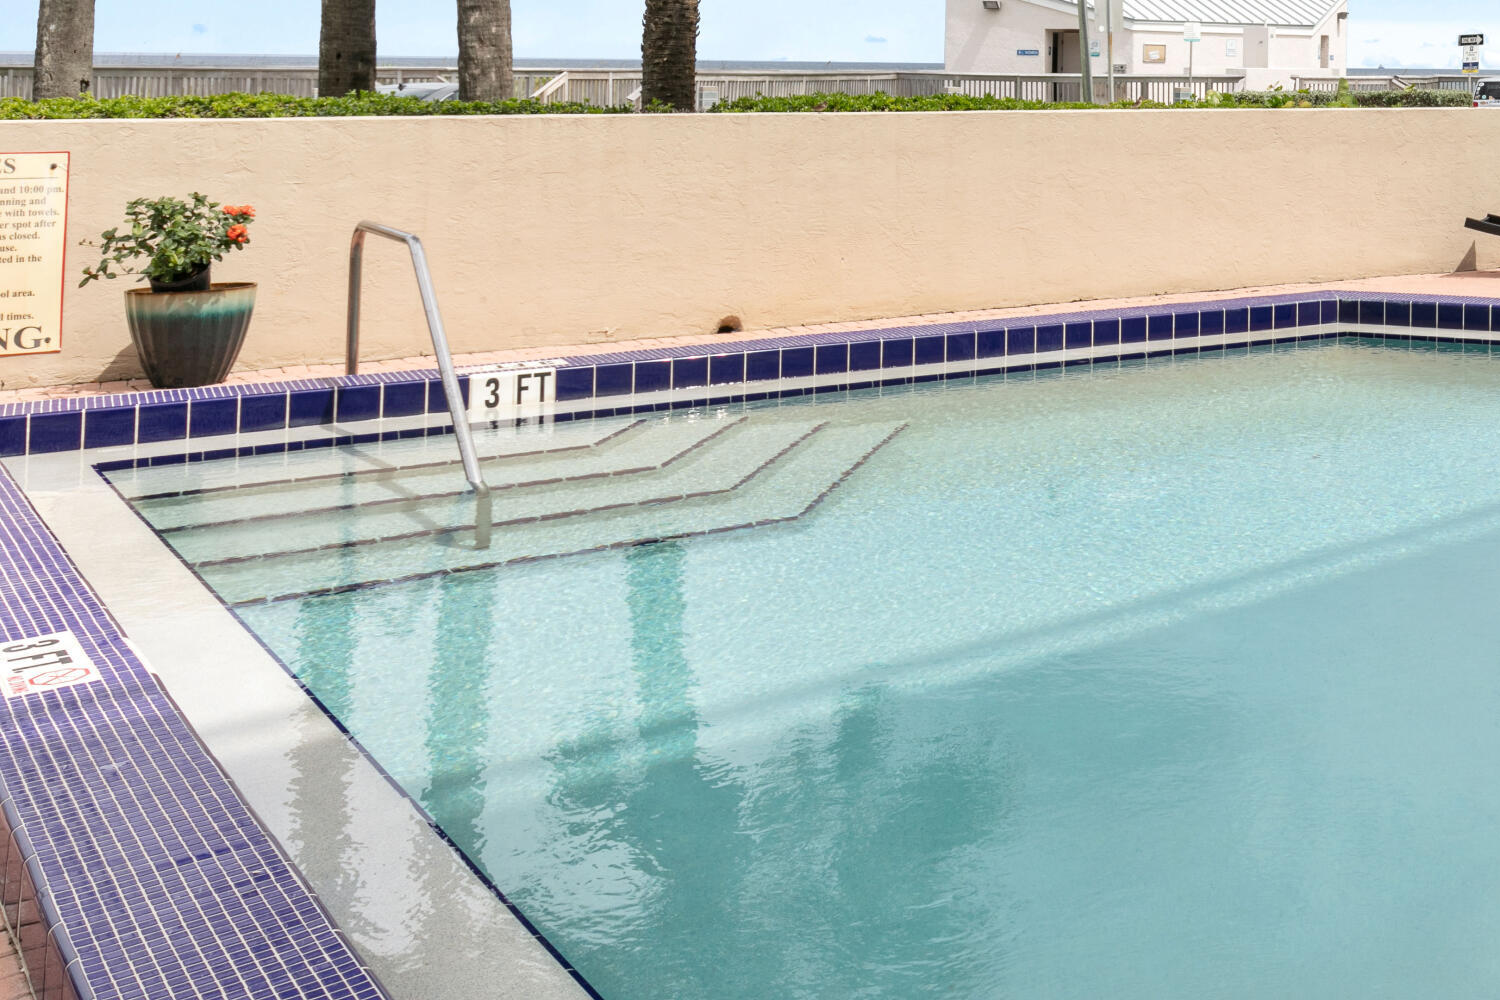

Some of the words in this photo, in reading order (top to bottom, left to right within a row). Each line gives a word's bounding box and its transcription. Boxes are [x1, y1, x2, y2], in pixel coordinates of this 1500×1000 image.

[0, 158, 16, 174] S
[20, 185, 44, 194] 10:00
[29, 196, 46, 205] and
[5, 208, 25, 217] with
[28, 207, 60, 217] towels.
[12, 221, 31, 231] spot
[34, 219, 56, 228] after
[9, 231, 40, 240] closed.
[16, 255, 25, 263] in
[27, 254, 42, 262] the
[7, 313, 34, 321] times.
[485, 378, 500, 408] 3
[517, 372, 551, 405] FT
[2, 639, 60, 653] 3
